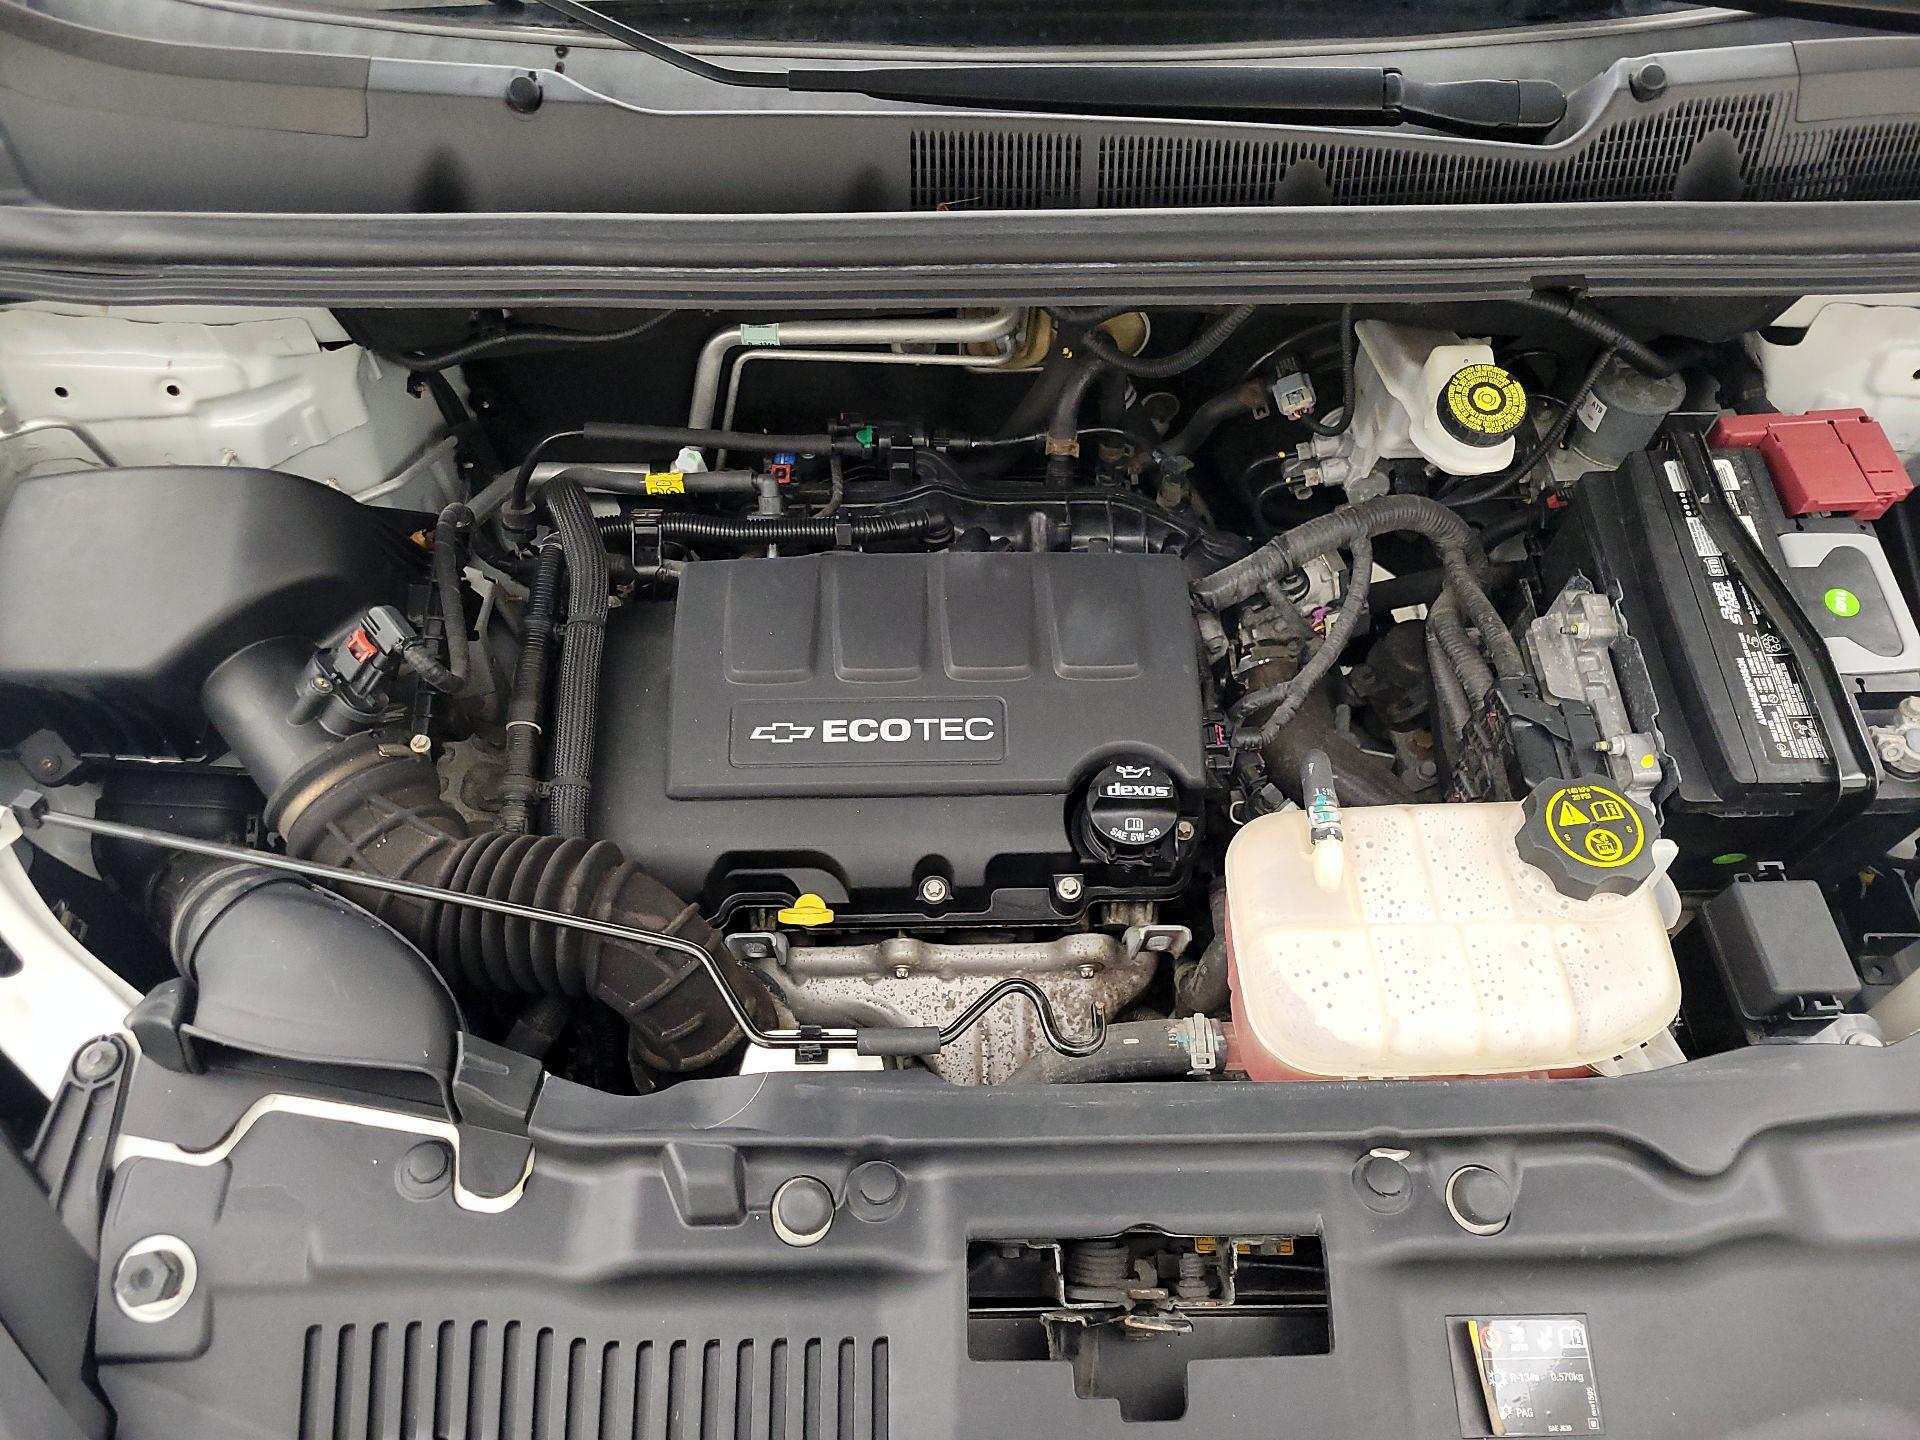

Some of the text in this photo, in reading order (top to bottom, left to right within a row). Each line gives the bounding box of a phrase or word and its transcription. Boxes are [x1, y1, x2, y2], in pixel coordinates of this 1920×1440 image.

[1712, 581, 1731, 620] SUPER
[821, 717, 994, 743] ECOTEC
[1106, 782, 1170, 797] dexos
[1110, 827, 1160, 841] SAE 5W-30
[1551, 1371, 1584, 1383] 0.570kg
[1516, 1407, 1534, 1418] PAG
